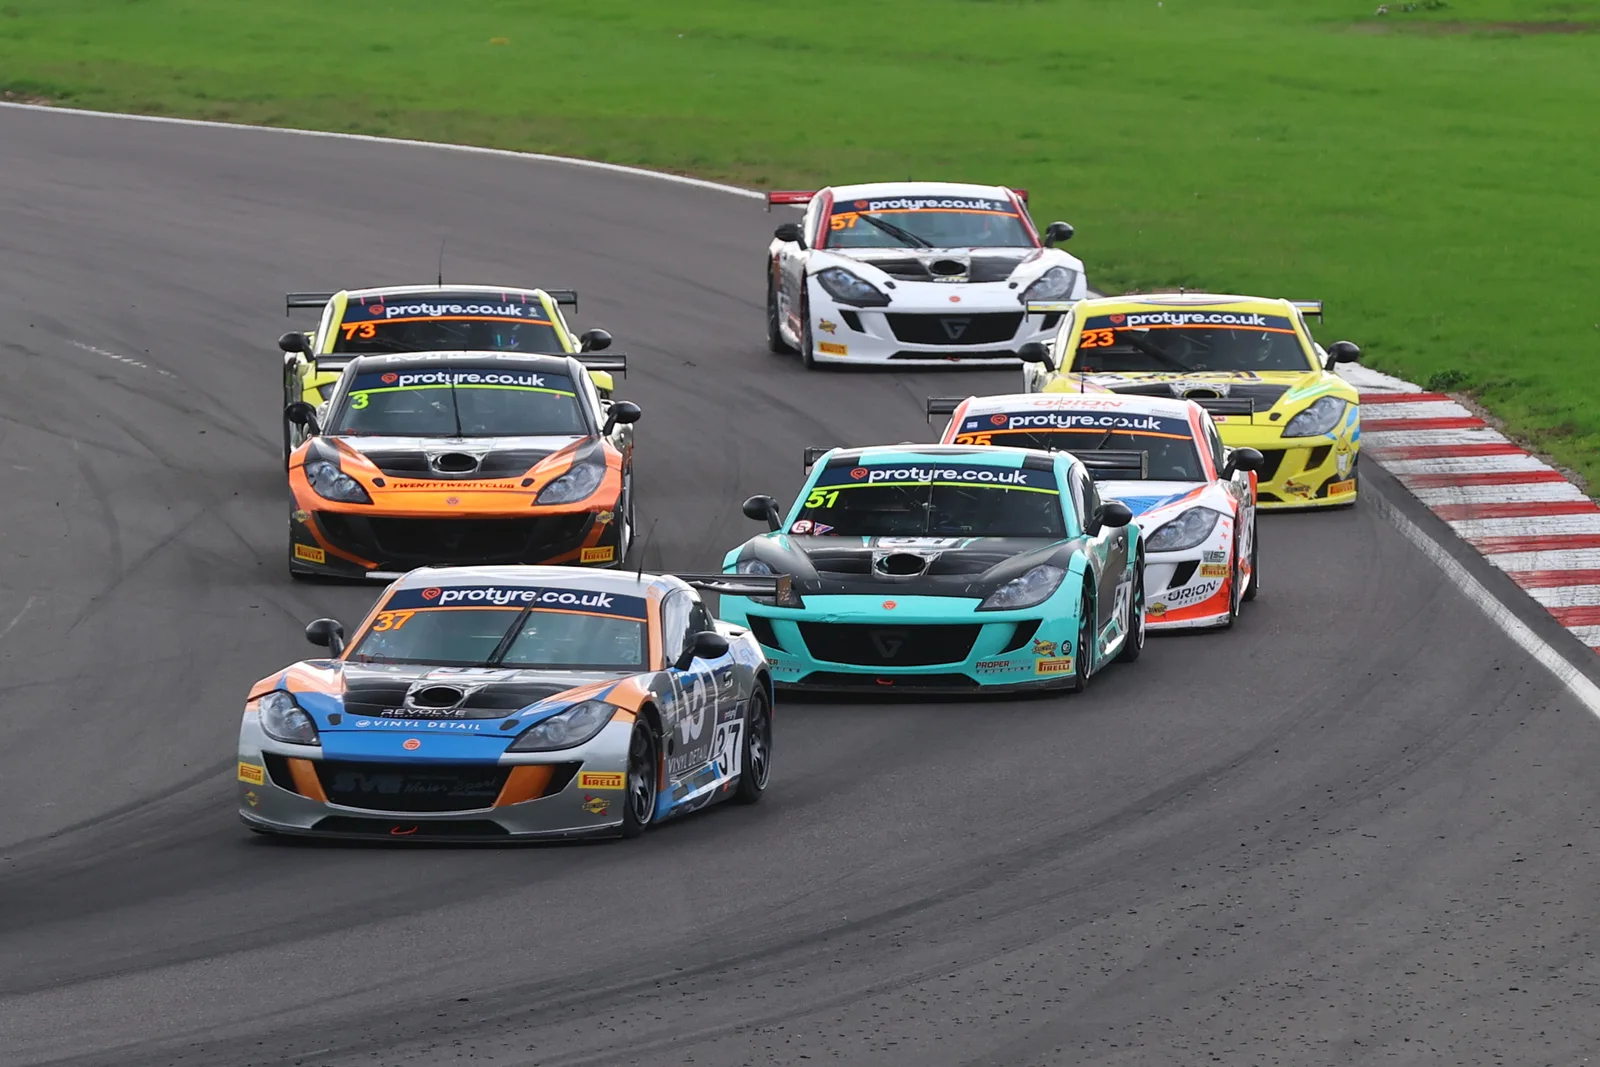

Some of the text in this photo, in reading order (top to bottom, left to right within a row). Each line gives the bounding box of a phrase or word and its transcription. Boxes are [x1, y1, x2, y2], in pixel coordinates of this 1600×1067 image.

[870, 198, 991, 211] protyre.co.uk
[830, 214, 859, 231] 57
[386, 303, 522, 318] protyre.co.uk
[1127, 311, 1265, 327] protyre.co.uk
[341, 323, 376, 341] 73
[1080, 331, 1114, 348] 23
[399, 371, 545, 387] protyre.co.uk
[351, 393, 369, 409] 3
[1009, 413, 1161, 430] protyre.co.uk
[869, 467, 1028, 484] protyre.co.uk
[805, 491, 839, 508] 51
[439, 586, 614, 608] protyre.co.uk
[1168, 581, 1216, 601] ORION
[373, 611, 415, 632] 37
[975, 660, 1010, 669] PROPER
[1039, 660, 1071, 672] PIRELLI
[380, 708, 467, 716] REVOLVE
[373, 720, 481, 731] VINYL DETAIL
[716, 723, 741, 776] 37
[583, 774, 622, 786] PIRELLI
